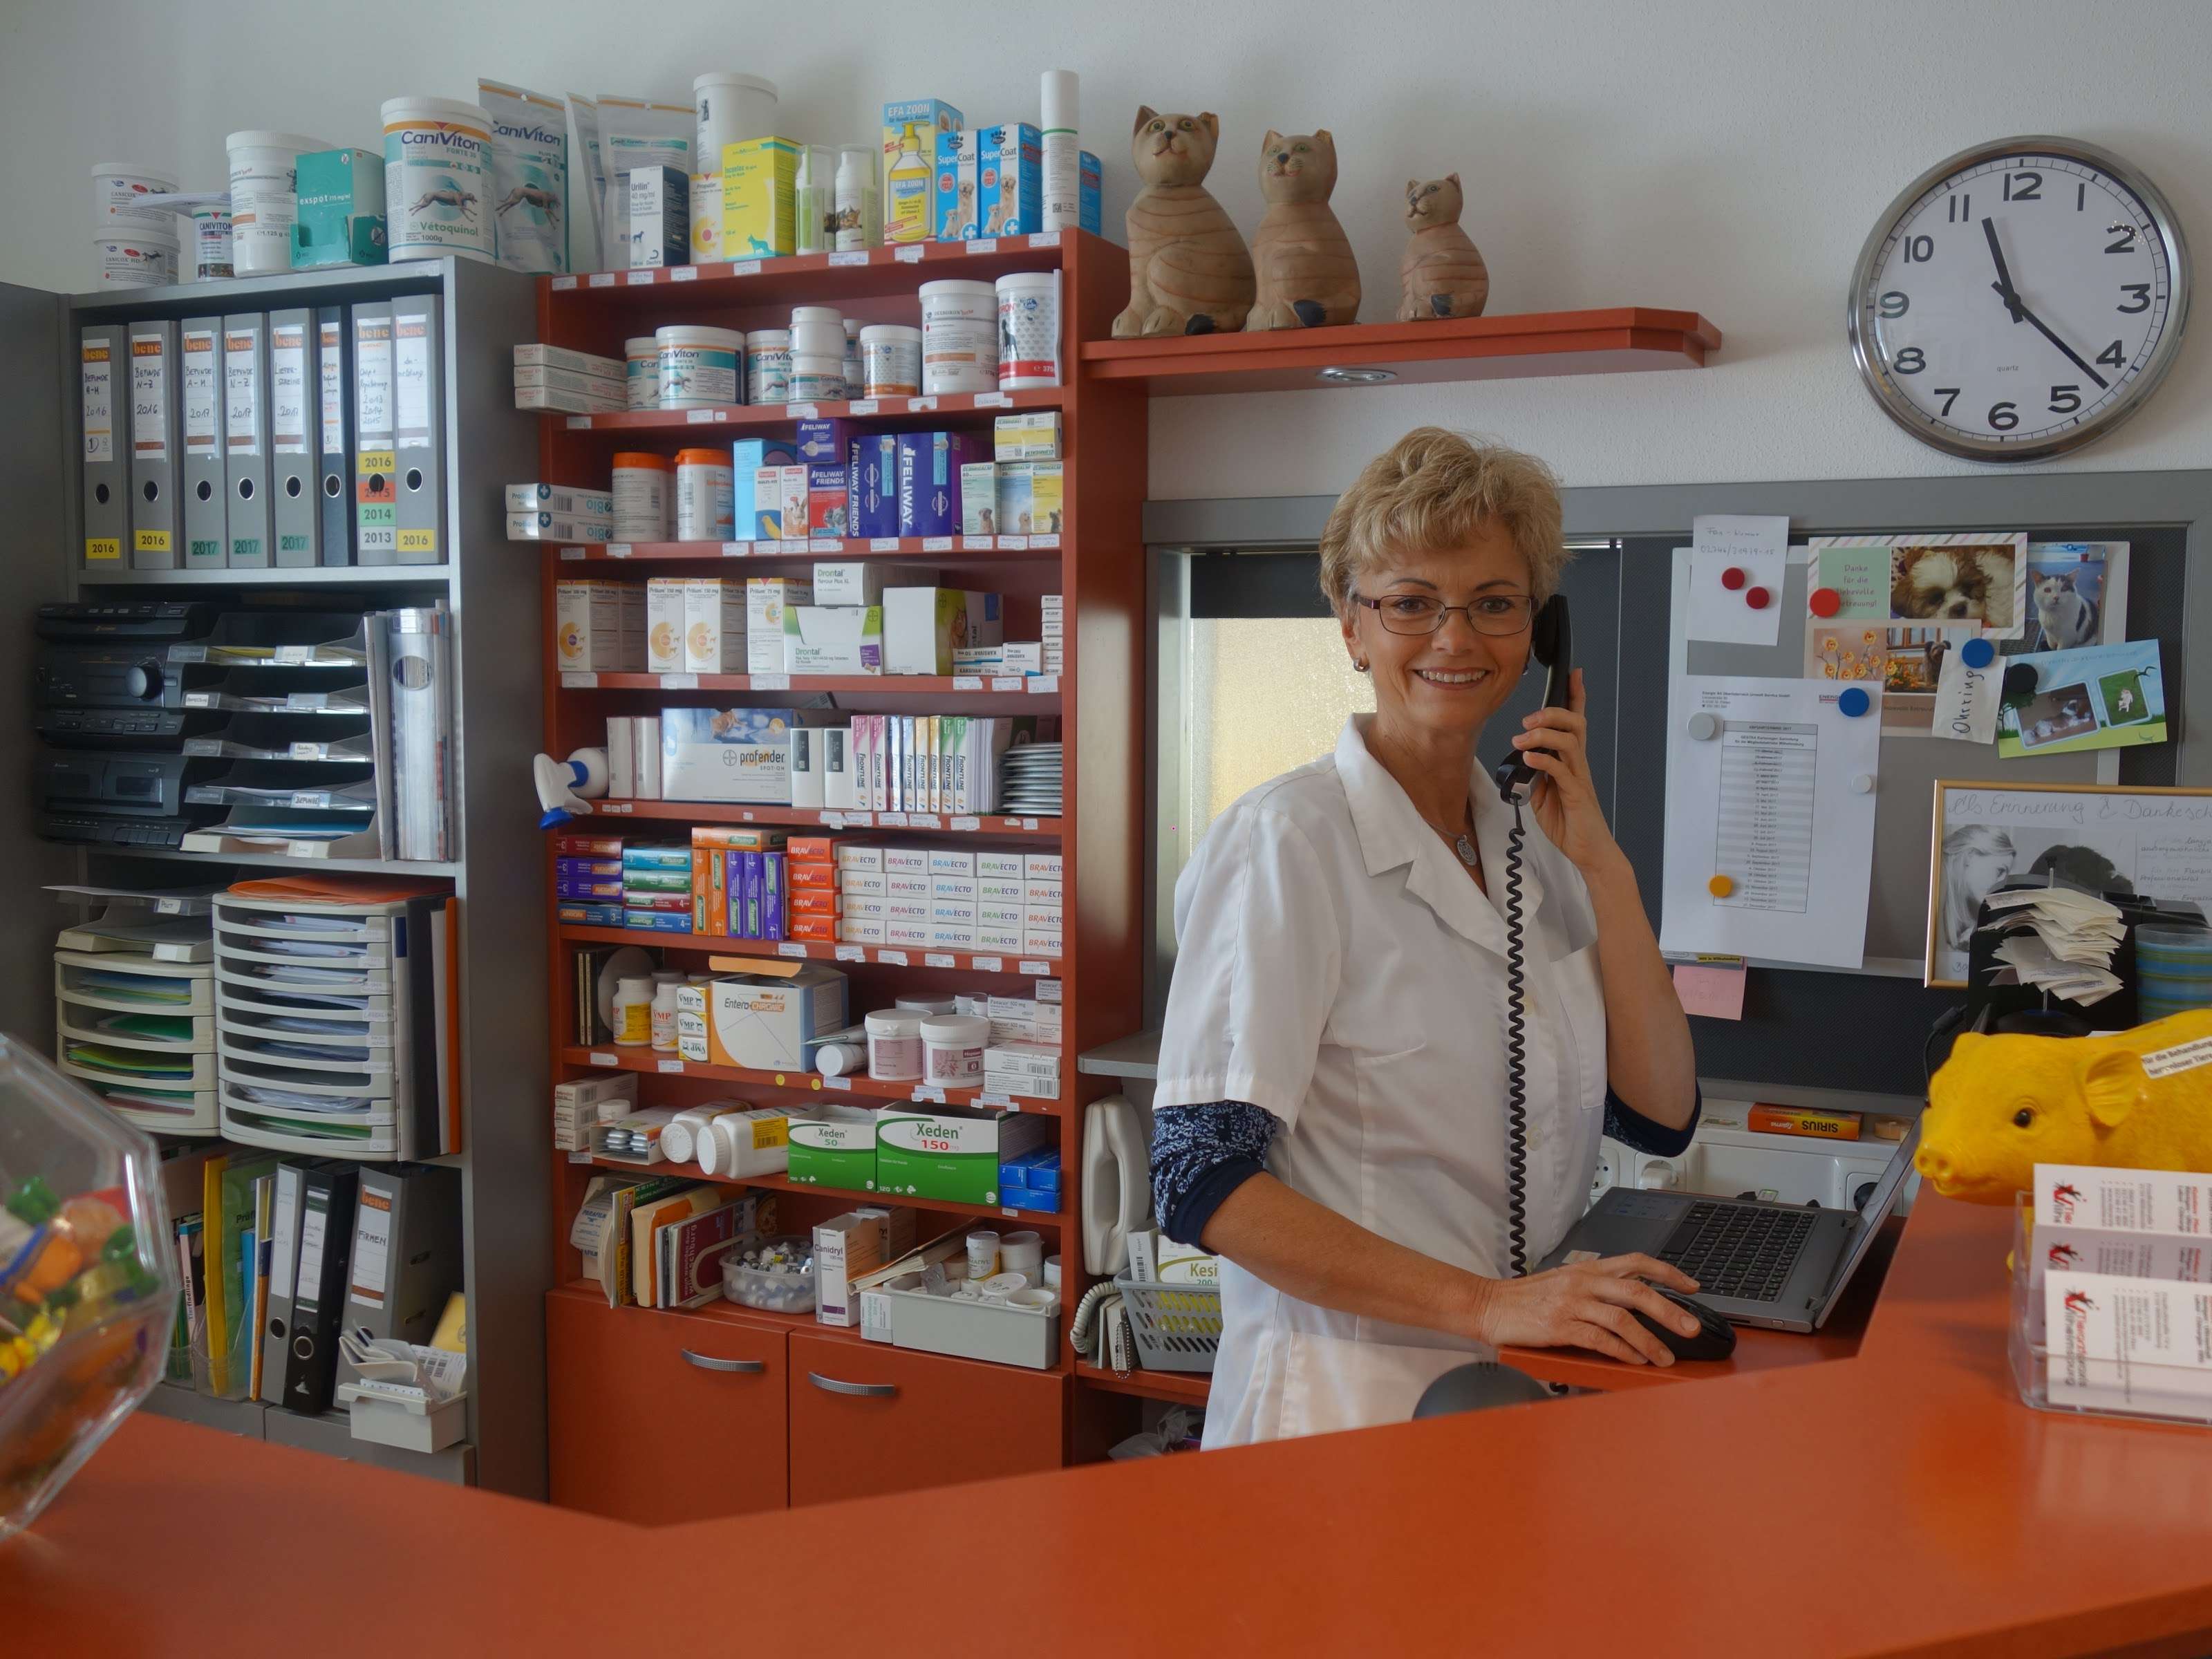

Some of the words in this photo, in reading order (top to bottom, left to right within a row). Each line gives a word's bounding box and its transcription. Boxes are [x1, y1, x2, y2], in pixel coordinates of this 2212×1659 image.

[888, 107, 903, 117] EFA
[907, 104, 930, 114] ZOON
[401, 129, 481, 152] CaniViton
[631, 182, 648, 191] Urilin
[2003, 172, 2043, 201] 12
[299, 194, 328, 205] exspot
[2077, 183, 2085, 212] 1
[1949, 194, 1970, 223] 11
[420, 221, 478, 236] Vétoquinol
[421, 234, 442, 243] 1000g
[2104, 224, 2137, 254] 2
[1904, 235, 1934, 263] 10
[1879, 291, 1910, 319] 9
[2116, 283, 2150, 314] 3
[359, 326, 389, 339] bene
[396, 319, 424, 337] bene
[186, 335, 211, 350] bene
[227, 335, 253, 350] bene
[274, 332, 302, 346] bene
[134, 341, 160, 354] bene
[2095, 339, 2127, 368] 4
[1893, 347, 1927, 375] 8
[1934, 388, 1961, 417] 7
[2047, 385, 2081, 413] 5
[137, 404, 158, 415] 2016
[1988, 402, 2019, 431] 6
[805, 422, 830, 431] FELIWAY
[365, 457, 391, 468] 2016
[851, 451, 859, 492] FELIWAY
[902, 456, 913, 527] FELIWAY
[364, 508, 392, 521] 2014
[142, 535, 165, 546] 2016
[281, 536, 306, 550] 2017
[364, 532, 392, 544] 2013
[402, 535, 428, 546] 2016
[92, 543, 115, 554] 2016
[192, 542, 218, 556] 2017
[234, 539, 259, 554] 2017
[818, 569, 843, 577] Drontal
[740, 749, 785, 767] profender
[1989, 794, 2085, 824] Erinnerung
[842, 854, 877, 865] BRAVECTO
[888, 855, 922, 867] BRAVECTO
[932, 856, 968, 869] BRAVECTO
[981, 861, 1018, 872] BRAVECTO
[845, 879, 881, 889] BRAVECTO
[891, 881, 926, 892] BRAVECTO
[936, 883, 972, 894] BRAVECTO
[982, 885, 1019, 897] BRAVECTO
[847, 903, 881, 913] BRAVECTO
[890, 905, 926, 916] BRAVECTO
[935, 907, 971, 919] BRAVECTO
[982, 910, 1018, 921] BRAVECTO
[846, 926, 880, 936] BRAVECTO
[890, 928, 926, 939] BRAVECTO
[935, 931, 971, 943] BRAVECTO
[982, 935, 1018, 946] BRAVECTO
[679, 994, 694, 1004] VMP
[653, 1011, 671, 1020] VMP
[679, 1020, 695, 1029] VMP
[691, 1044, 706, 1055] VMP
[818, 1127, 846, 1139] Xeden
[916, 1123, 959, 1140] Xeden
[1802, 1120, 1839, 1134] SIRIUS
[921, 1140, 949, 1151] 150
[362, 1188, 390, 1210] bene
[358, 1230, 386, 1245] FIRMEN
[814, 1244, 843, 1256] Canidryl
[1190, 1262, 1218, 1277] Kesi
